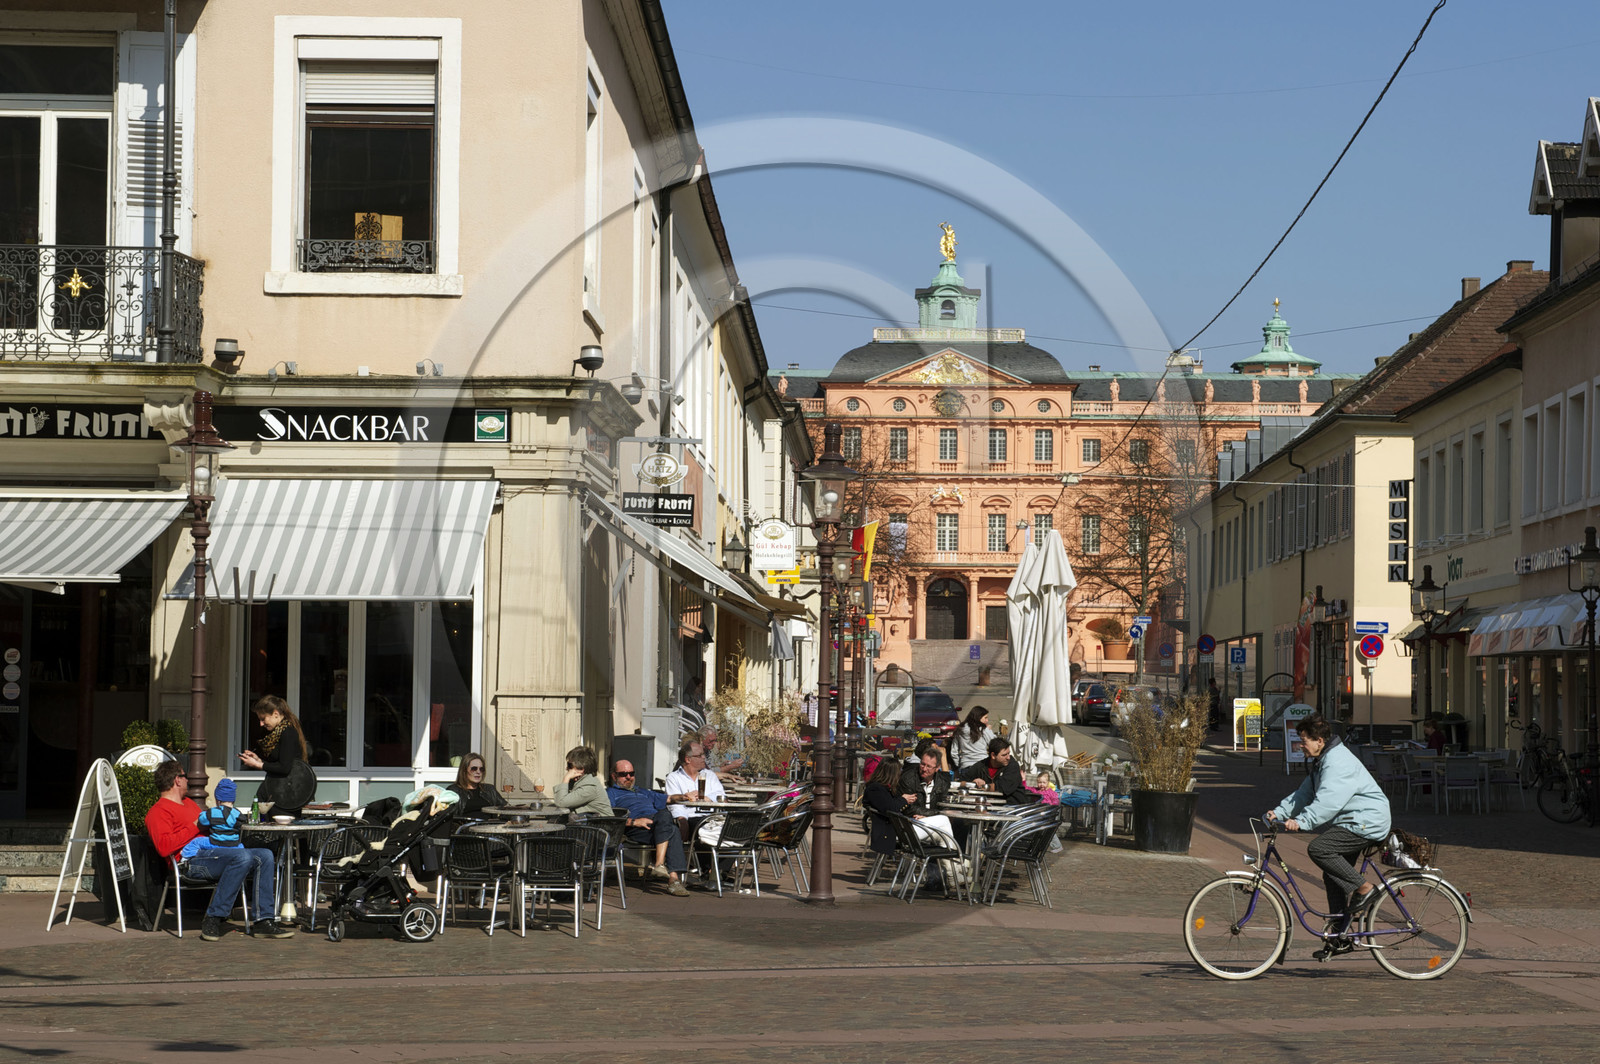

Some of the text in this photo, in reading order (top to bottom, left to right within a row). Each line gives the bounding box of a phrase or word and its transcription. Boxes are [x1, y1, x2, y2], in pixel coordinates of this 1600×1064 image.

[257, 408, 430, 442] SNACKBAR
[648, 465, 672, 474] HATZ
[658, 496, 692, 510] FRUTTI
[1389, 482, 1404, 581] MUSIK
[771, 542, 792, 551] Kebap
[1447, 554, 1463, 581] VOGT
[1290, 707, 1312, 715] VOGT
